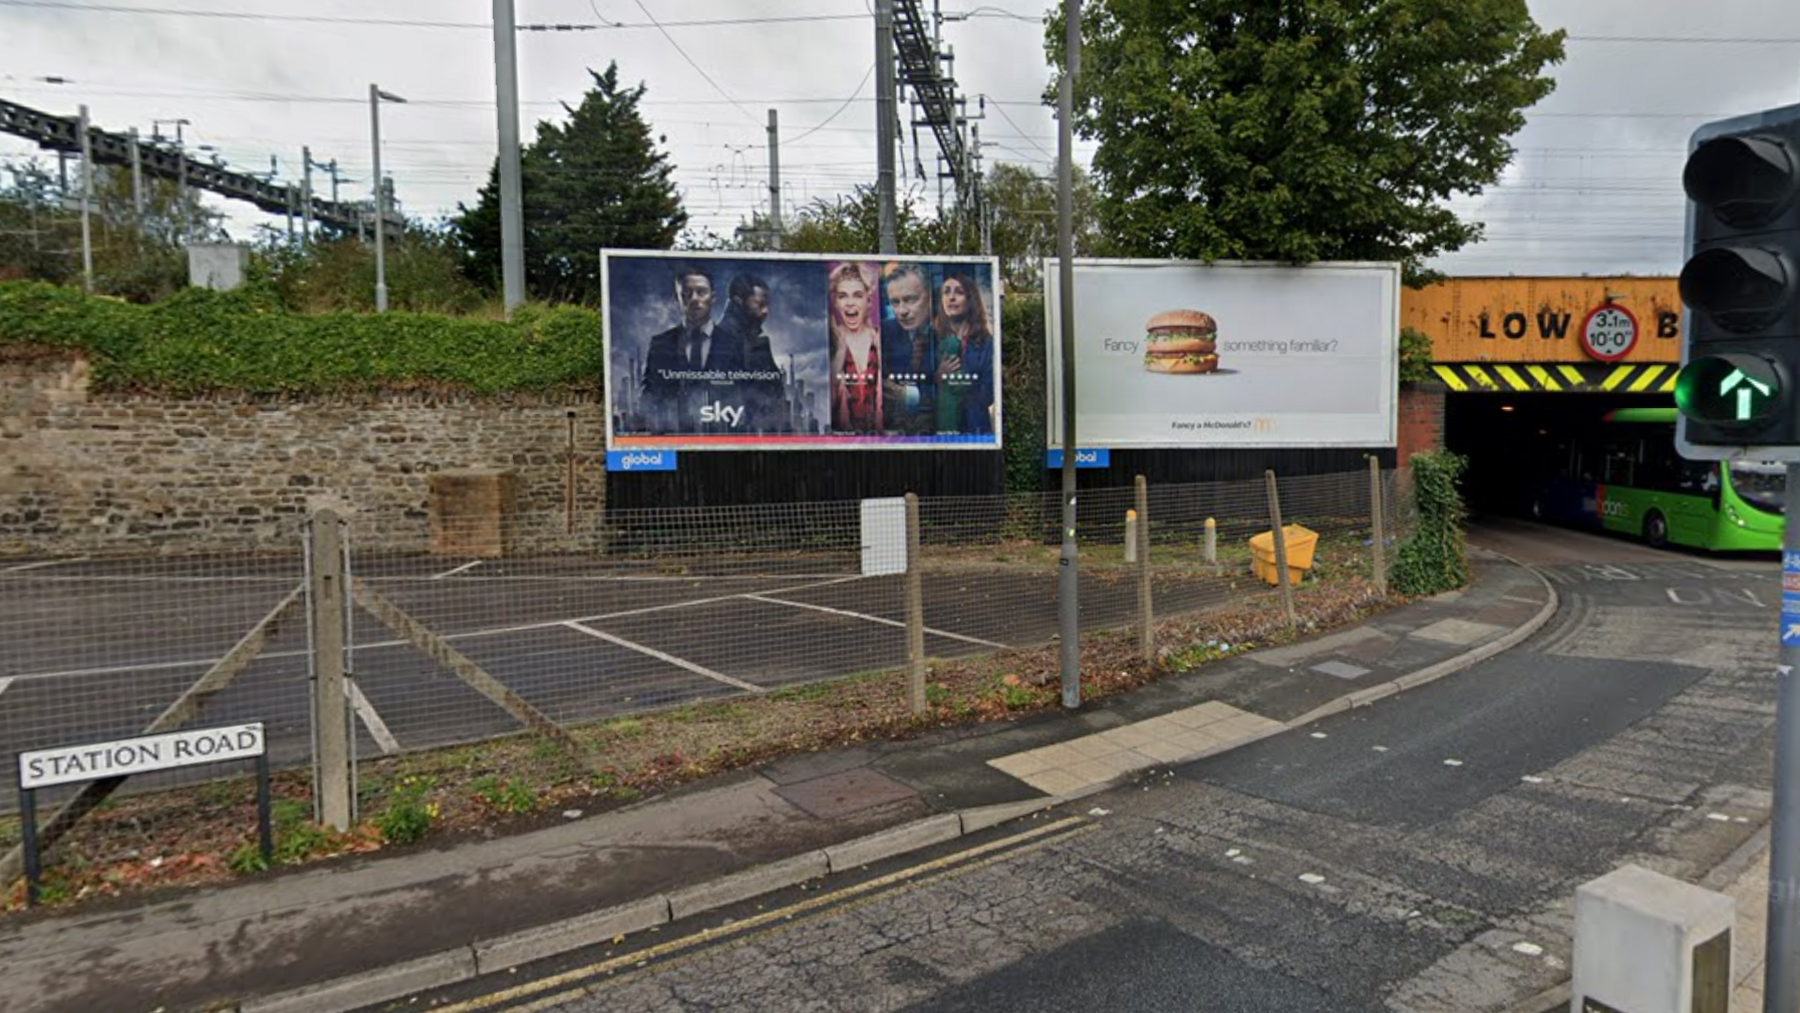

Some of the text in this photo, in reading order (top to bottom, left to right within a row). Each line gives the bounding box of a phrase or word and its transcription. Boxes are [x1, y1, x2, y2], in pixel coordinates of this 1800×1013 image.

[1479, 312, 1679, 339] LOW B
[1595, 313, 1630, 328] 3.1m
[1104, 338, 1338, 354] Fancy something familiar?
[657, 369, 785, 381] "Unmissable television"
[700, 400, 744, 427] sky
[1171, 421, 1195, 430] Fancy
[1203, 421, 1251, 430] McDonald's?
[621, 453, 663, 469] global
[28, 731, 257, 779] STATION ROAD
